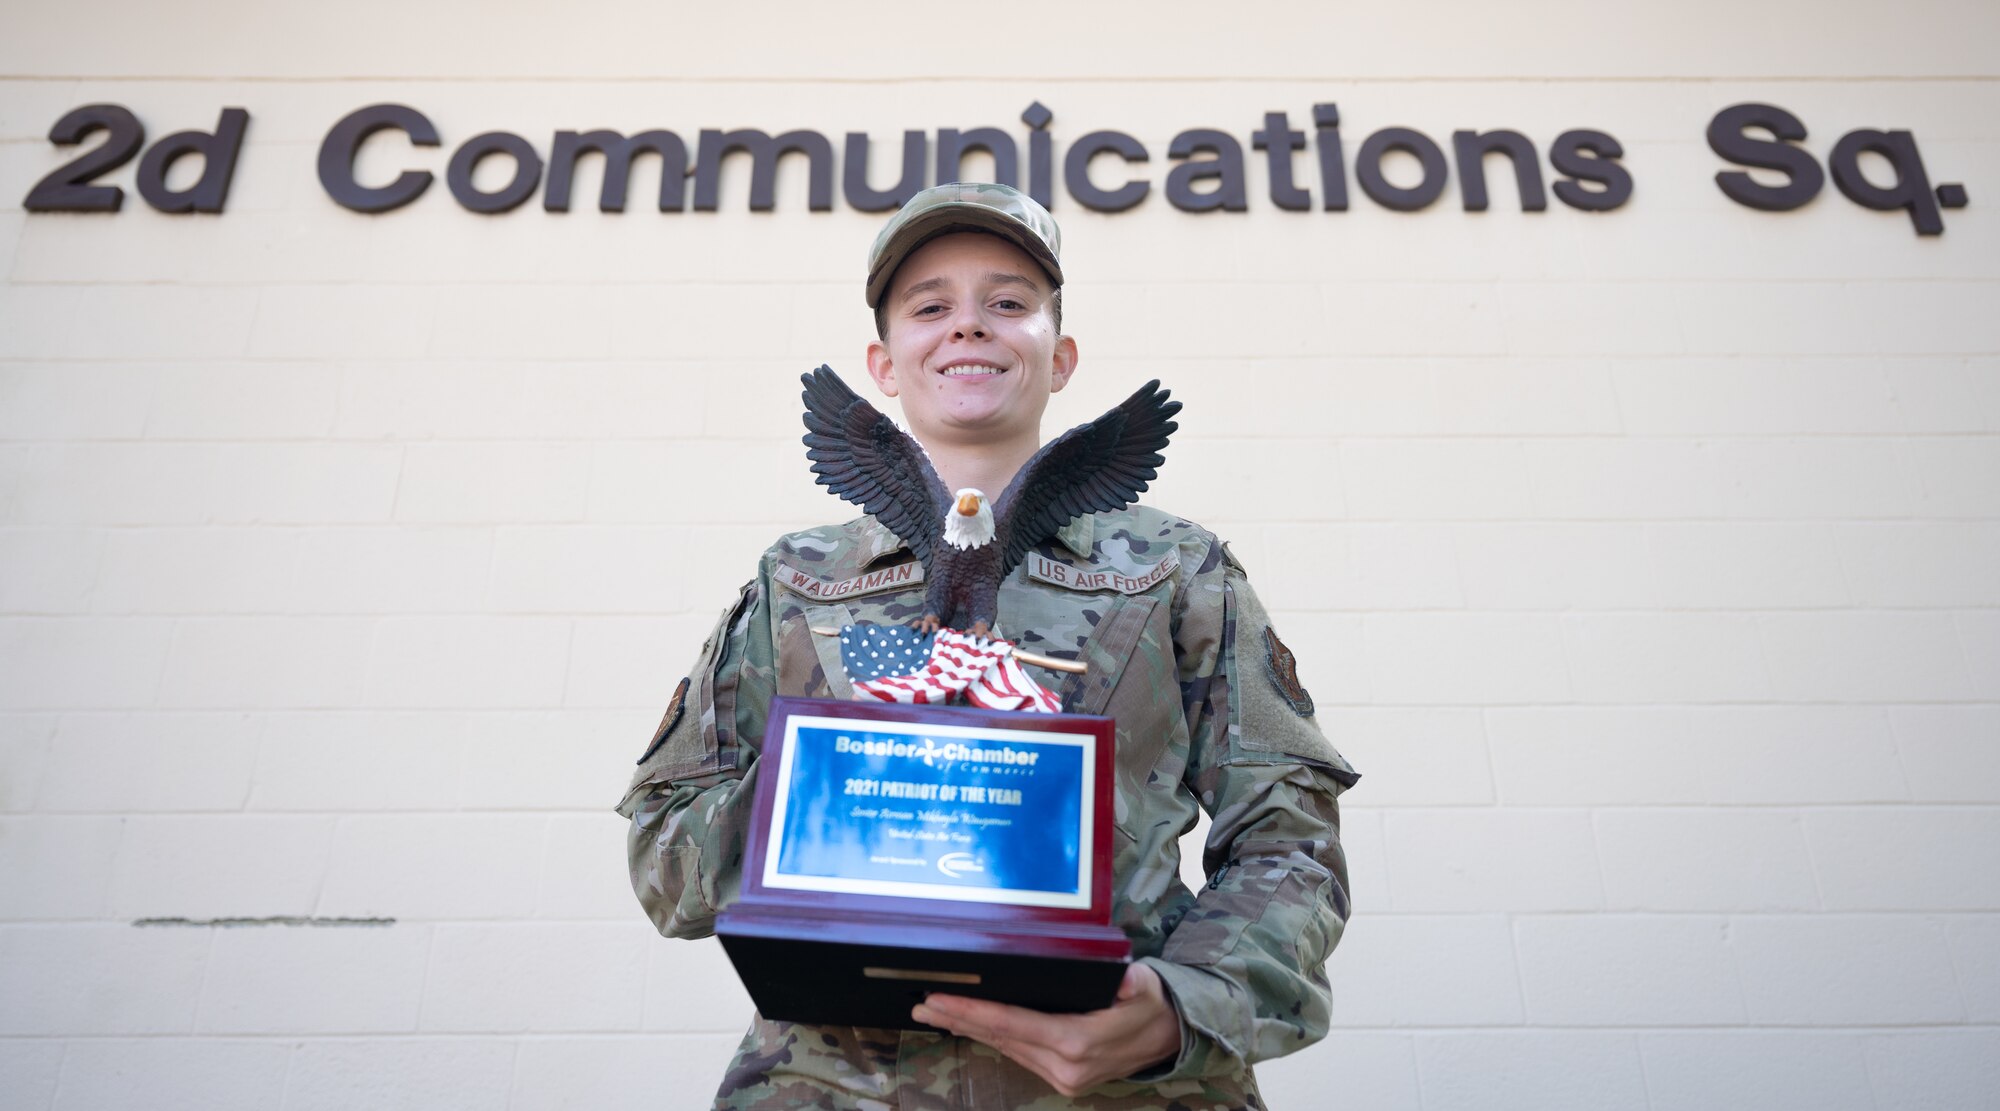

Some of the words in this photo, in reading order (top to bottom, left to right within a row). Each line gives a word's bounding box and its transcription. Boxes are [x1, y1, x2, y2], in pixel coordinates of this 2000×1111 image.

[24, 104, 250, 215] 2d
[318, 101, 1633, 215] Communications
[1707, 103, 1969, 236] Sq.
[791, 564, 913, 596] WAUGAMAN
[1075, 573, 1108, 588] AIR
[1113, 557, 1172, 591] FORCE
[835, 736, 917, 758] Bossier
[943, 743, 1040, 766] Chamber
[844, 778, 879, 796] 2021
[881, 781, 938, 800] PATRIOT
[939, 784, 958, 801] OF
[960, 786, 986, 803] THE
[987, 788, 1022, 805] YEAR
